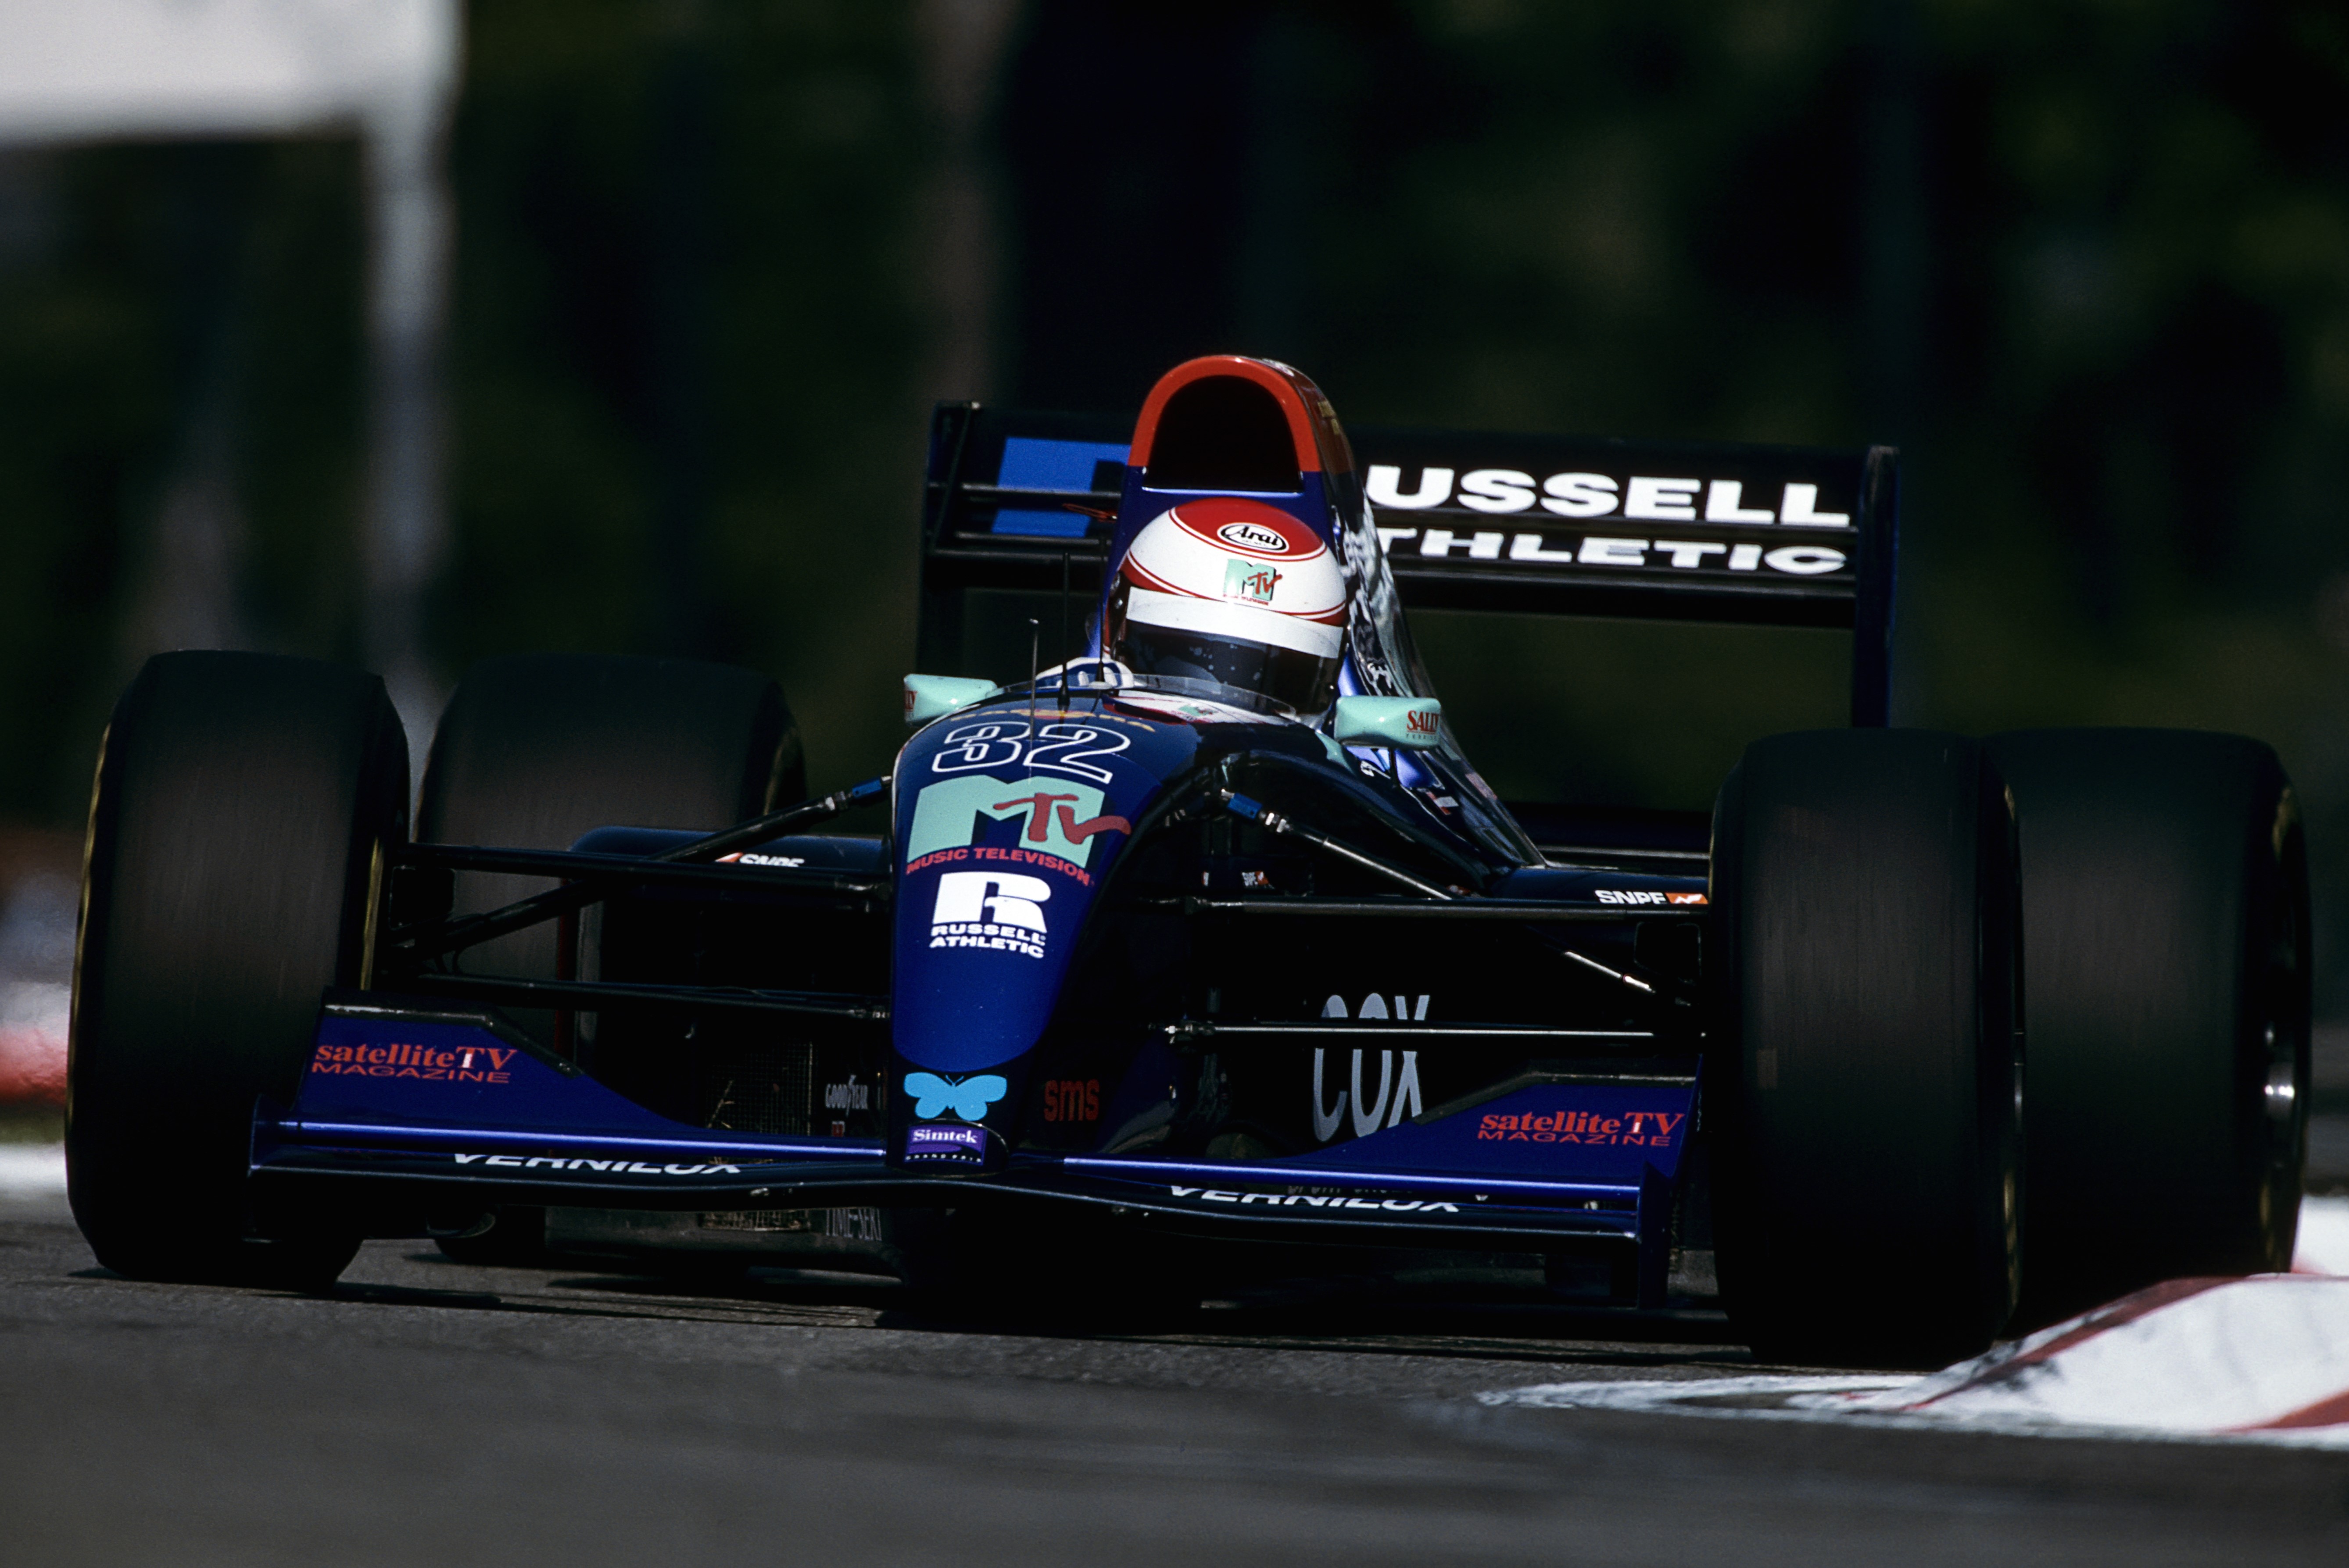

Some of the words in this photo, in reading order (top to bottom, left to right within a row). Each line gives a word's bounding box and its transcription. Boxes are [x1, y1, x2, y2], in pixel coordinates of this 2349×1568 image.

[1228, 525, 1278, 546] Arai
[1223, 558, 1283, 601] MTV
[932, 721, 1131, 784] 32
[907, 775, 1132, 868] MTV
[906, 848, 968, 875] MUSIC
[974, 848, 1091, 886] TELEVISION
[932, 872, 1051, 933] R
[931, 924, 1046, 946] RUSSELL
[929, 936, 1044, 958] ATHLETIC
[312, 1062, 511, 1084] MAGAZINE
[913, 1129, 978, 1143] Simtek
[1477, 1129, 1671, 1147] MAGAZINE
